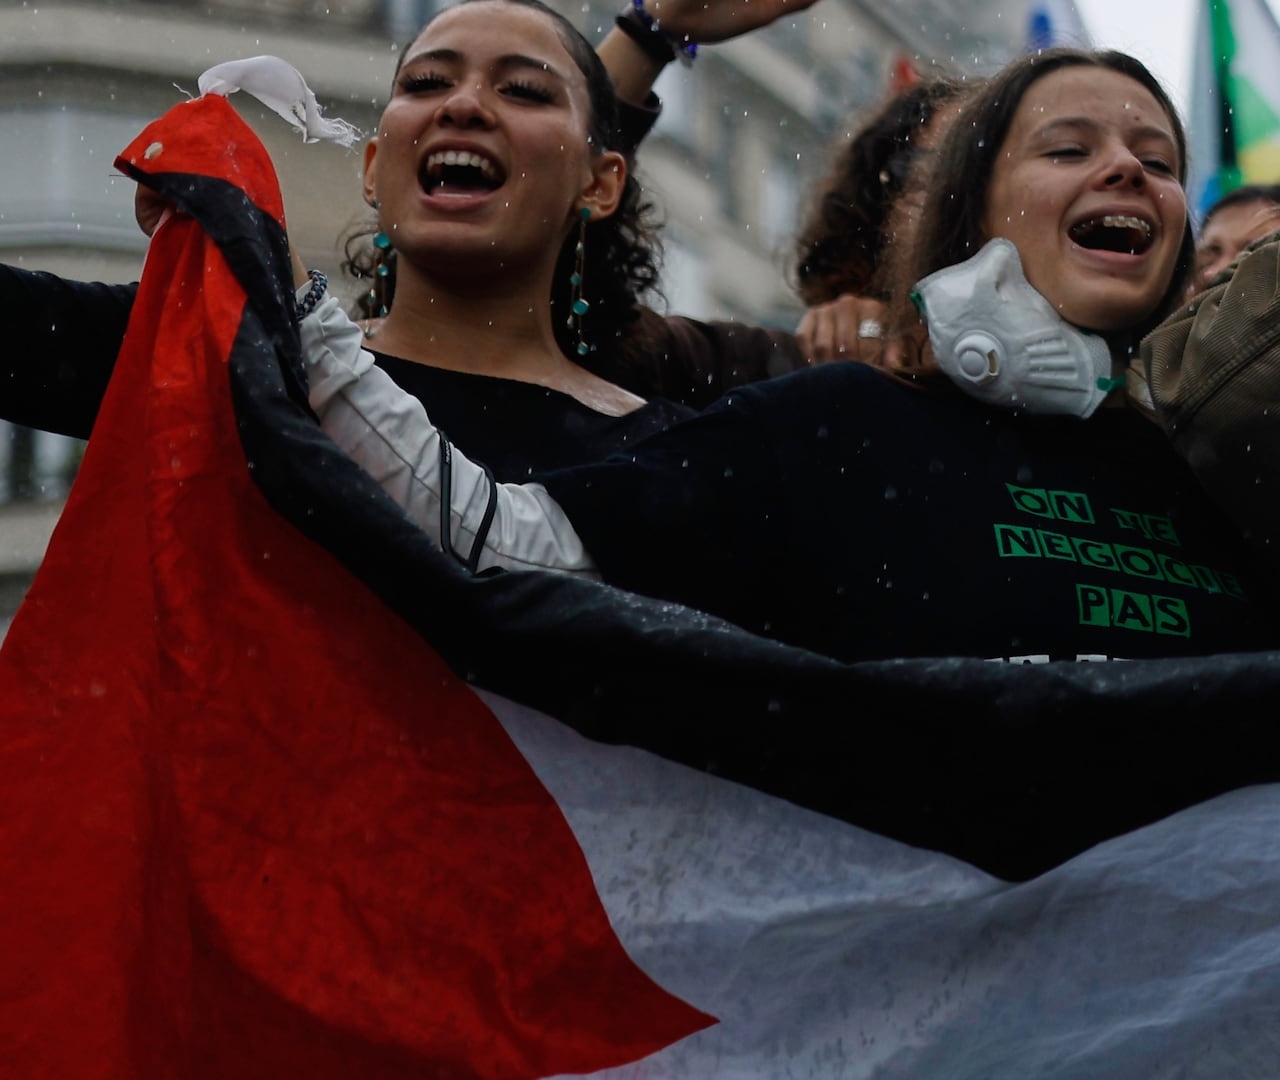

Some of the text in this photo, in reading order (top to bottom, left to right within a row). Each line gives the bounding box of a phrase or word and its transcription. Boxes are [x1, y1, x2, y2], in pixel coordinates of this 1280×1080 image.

[1009, 486, 1092, 522] ON
[997, 526, 1243, 595] NEGOCIE
[1079, 585, 1188, 635] PAS
